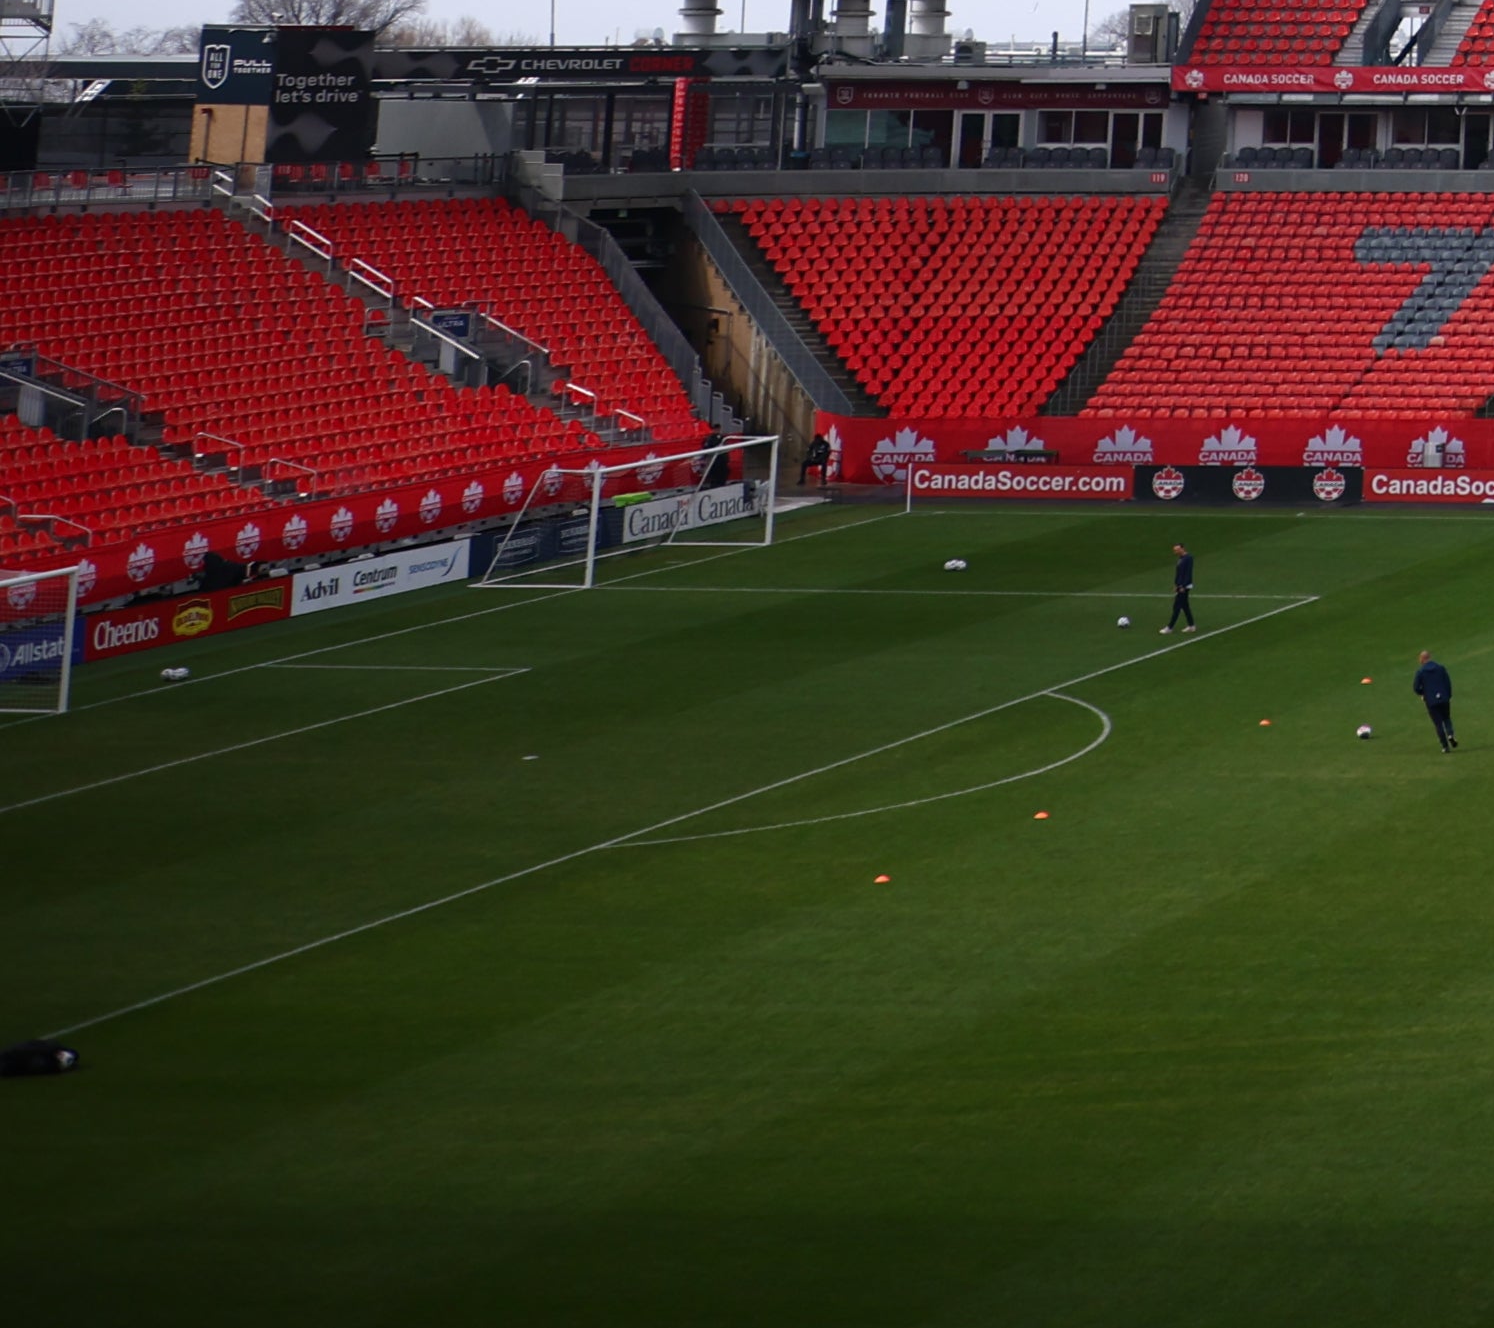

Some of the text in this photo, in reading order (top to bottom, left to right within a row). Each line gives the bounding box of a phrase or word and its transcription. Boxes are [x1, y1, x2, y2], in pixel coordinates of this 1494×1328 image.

[521, 59, 624, 70] CHEVROLET
[276, 73, 355, 89] Together
[1223, 74, 1313, 84] CANADA SOCCER
[1373, 74, 1464, 85] CANADA SOCCER
[275, 89, 360, 103] let's drive
[1152, 173, 1166, 182] 119
[1092, 453, 1152, 463] CANADA
[1199, 453, 1256, 462] CANADA
[1303, 453, 1361, 462] CANADA
[1406, 454, 1464, 464] CADA
[914, 469, 1125, 492] CanadaSoccer.com
[629, 506, 691, 537] Canada
[353, 565, 398, 587] Centrum
[300, 577, 340, 602] Advil
[94, 617, 159, 650] Cheerios
[10, 636, 66, 667] Allstat
